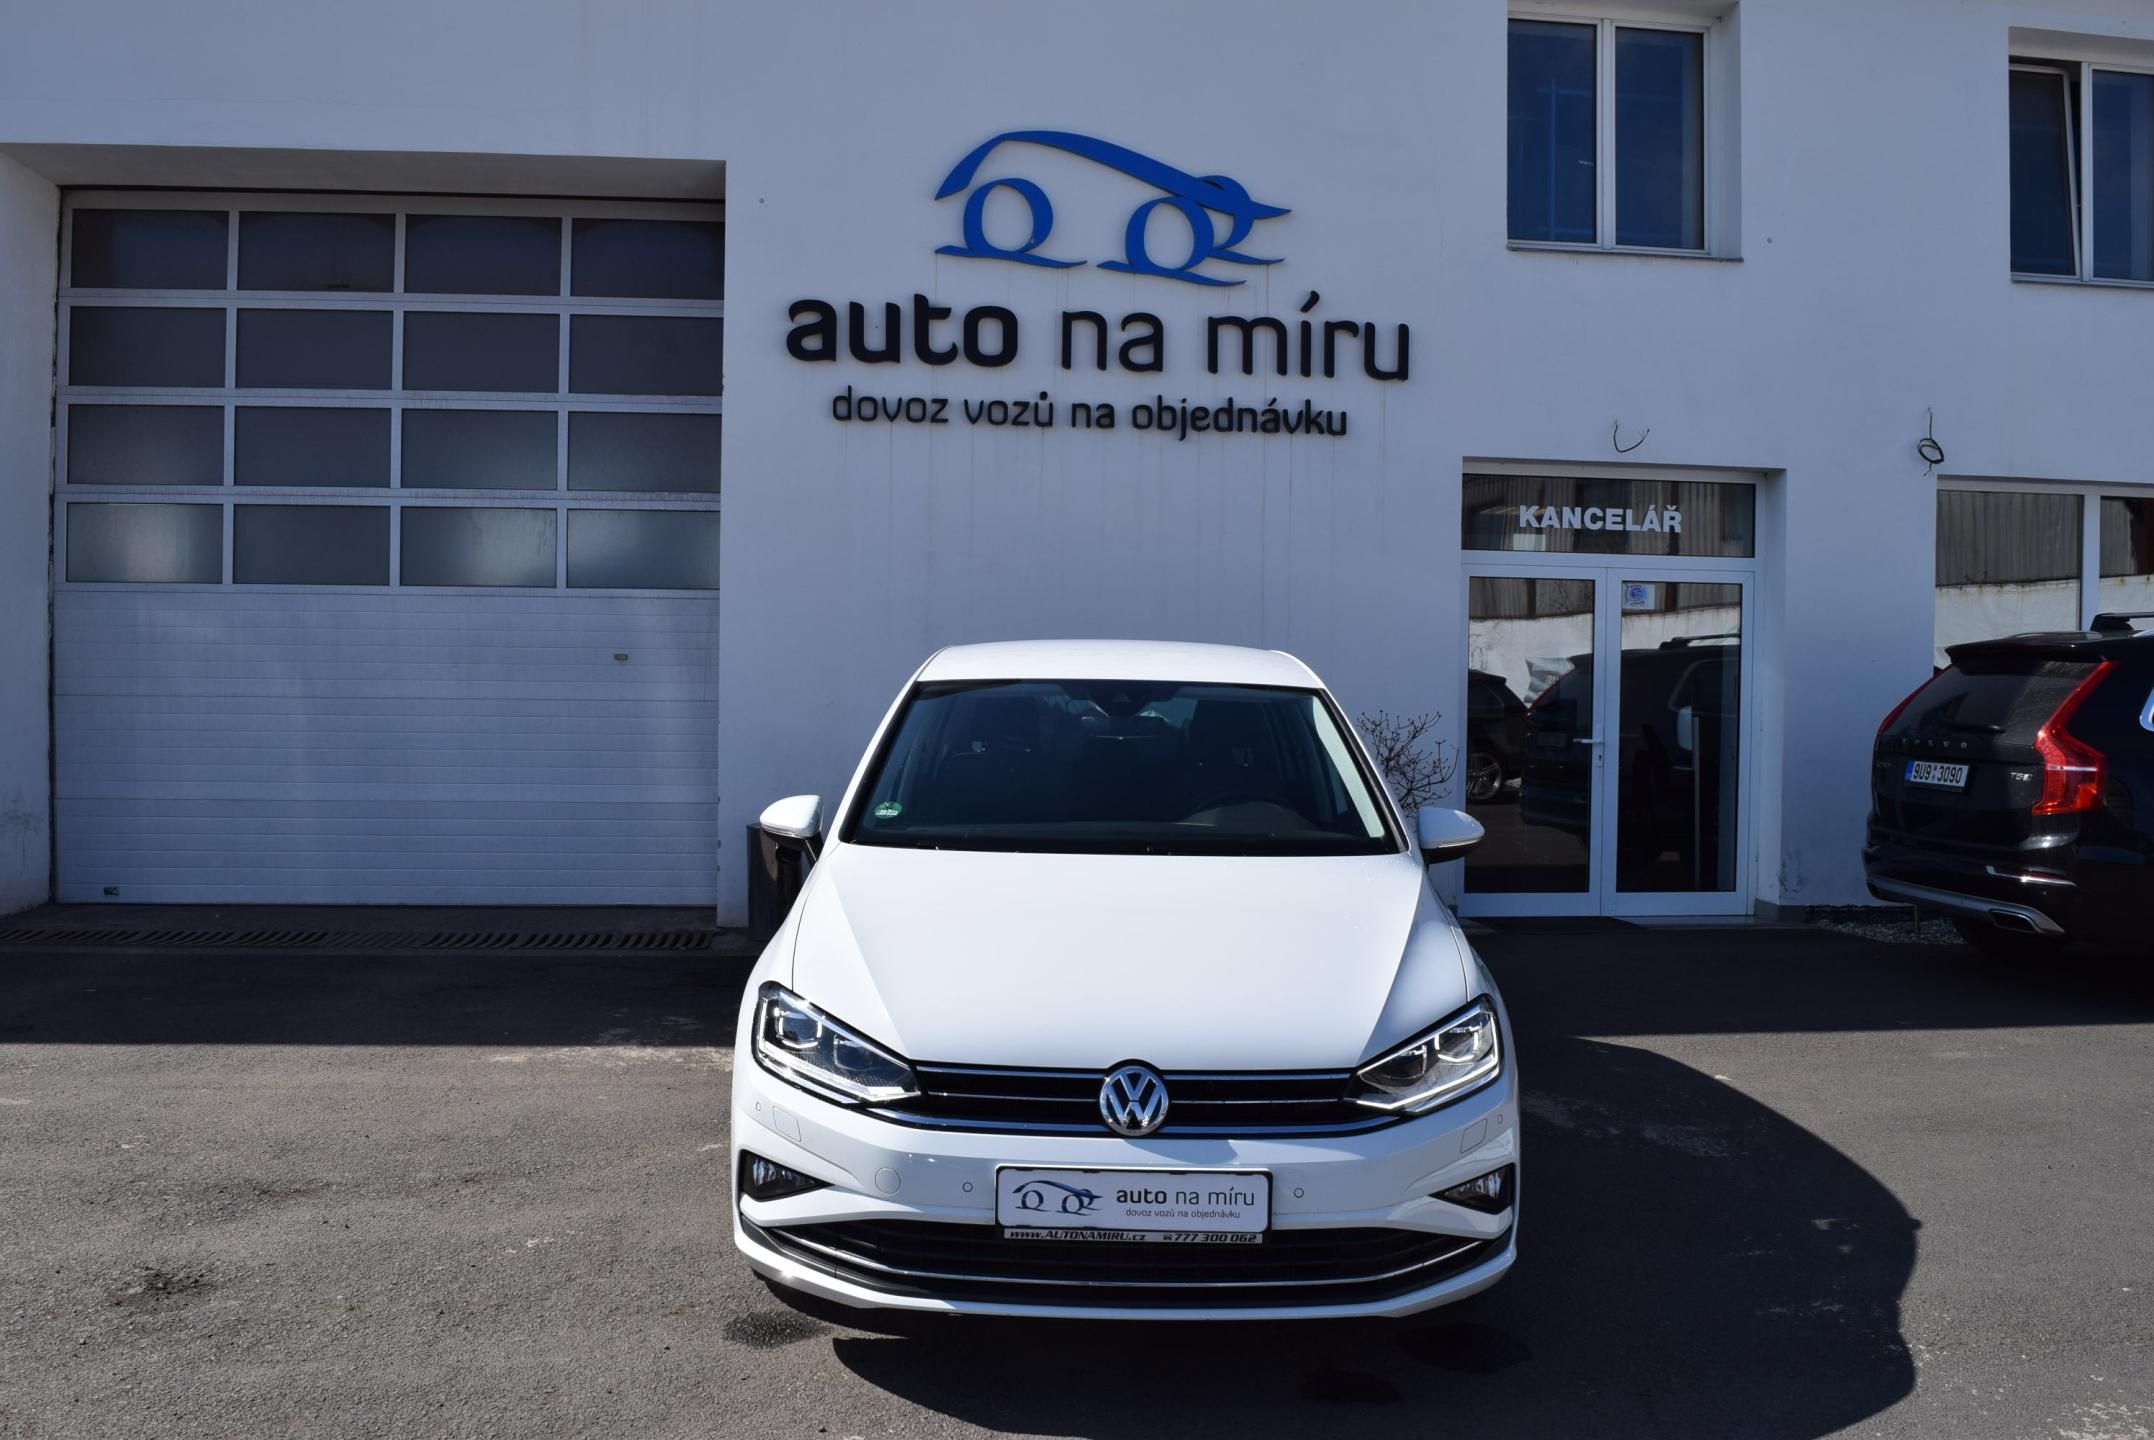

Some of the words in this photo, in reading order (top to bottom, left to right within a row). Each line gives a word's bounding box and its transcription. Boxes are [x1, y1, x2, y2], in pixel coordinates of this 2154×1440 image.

[785, 292, 1020, 369] auto
[1061, 309, 1164, 373] na
[1207, 289, 1411, 382] míru
[832, 385, 950, 425] dovoz
[963, 390, 1055, 428] vozů
[1070, 398, 1116, 430] na
[1131, 394, 1348, 442] objednávku
[1518, 503, 1683, 534] KANCELÁŘ
[1912, 763, 1933, 781] 9U9
[1936, 765, 1963, 784] 3090
[1116, 1188, 1168, 1205] auto
[1175, 1190, 1200, 1205] na
[1207, 1186, 1255, 1206] míru
[1125, 1207, 1152, 1217] dovoz
[1154, 1208, 1176, 1218] vozů
[1177, 1209, 1189, 1218] na
[1190, 1208, 1241, 1220] objednávku
[1174, 1232, 1199, 1242] 777
[1200, 1233, 1228, 1243] 300
[1230, 1234, 1258, 1243] 062
